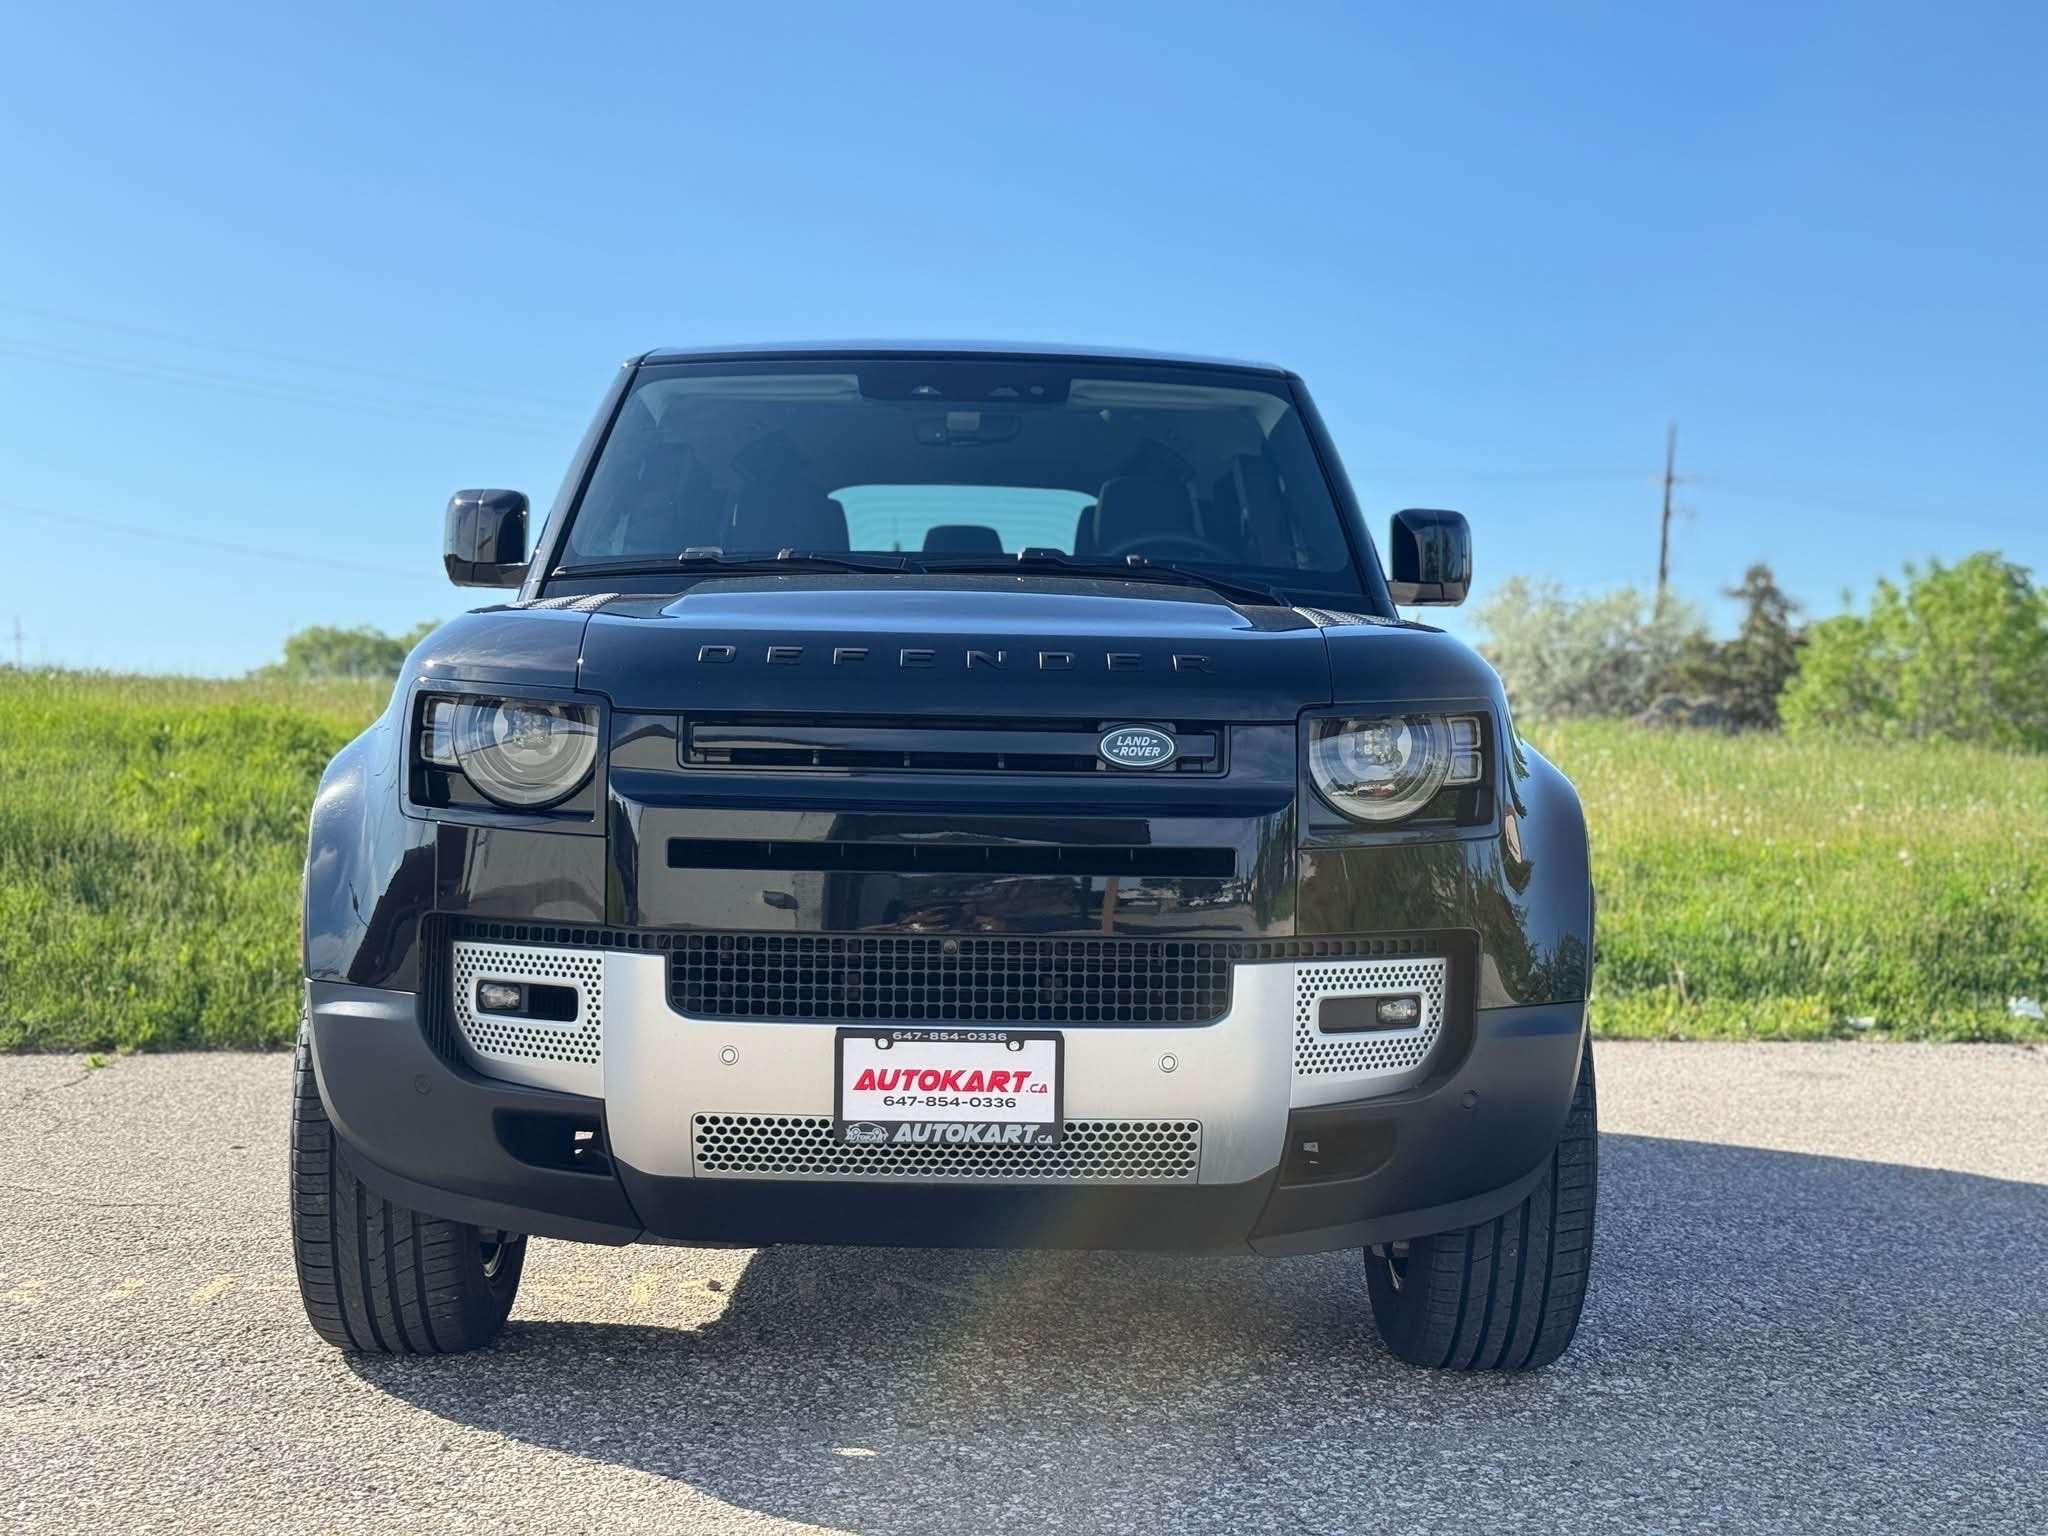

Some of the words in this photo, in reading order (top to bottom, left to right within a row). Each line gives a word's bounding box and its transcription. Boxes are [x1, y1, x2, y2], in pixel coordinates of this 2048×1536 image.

[697, 645, 1215, 673] DEFENDER
[892, 1031, 1008, 1042] 647-854-0336
[883, 1096, 1017, 1109] 647-854-0336
